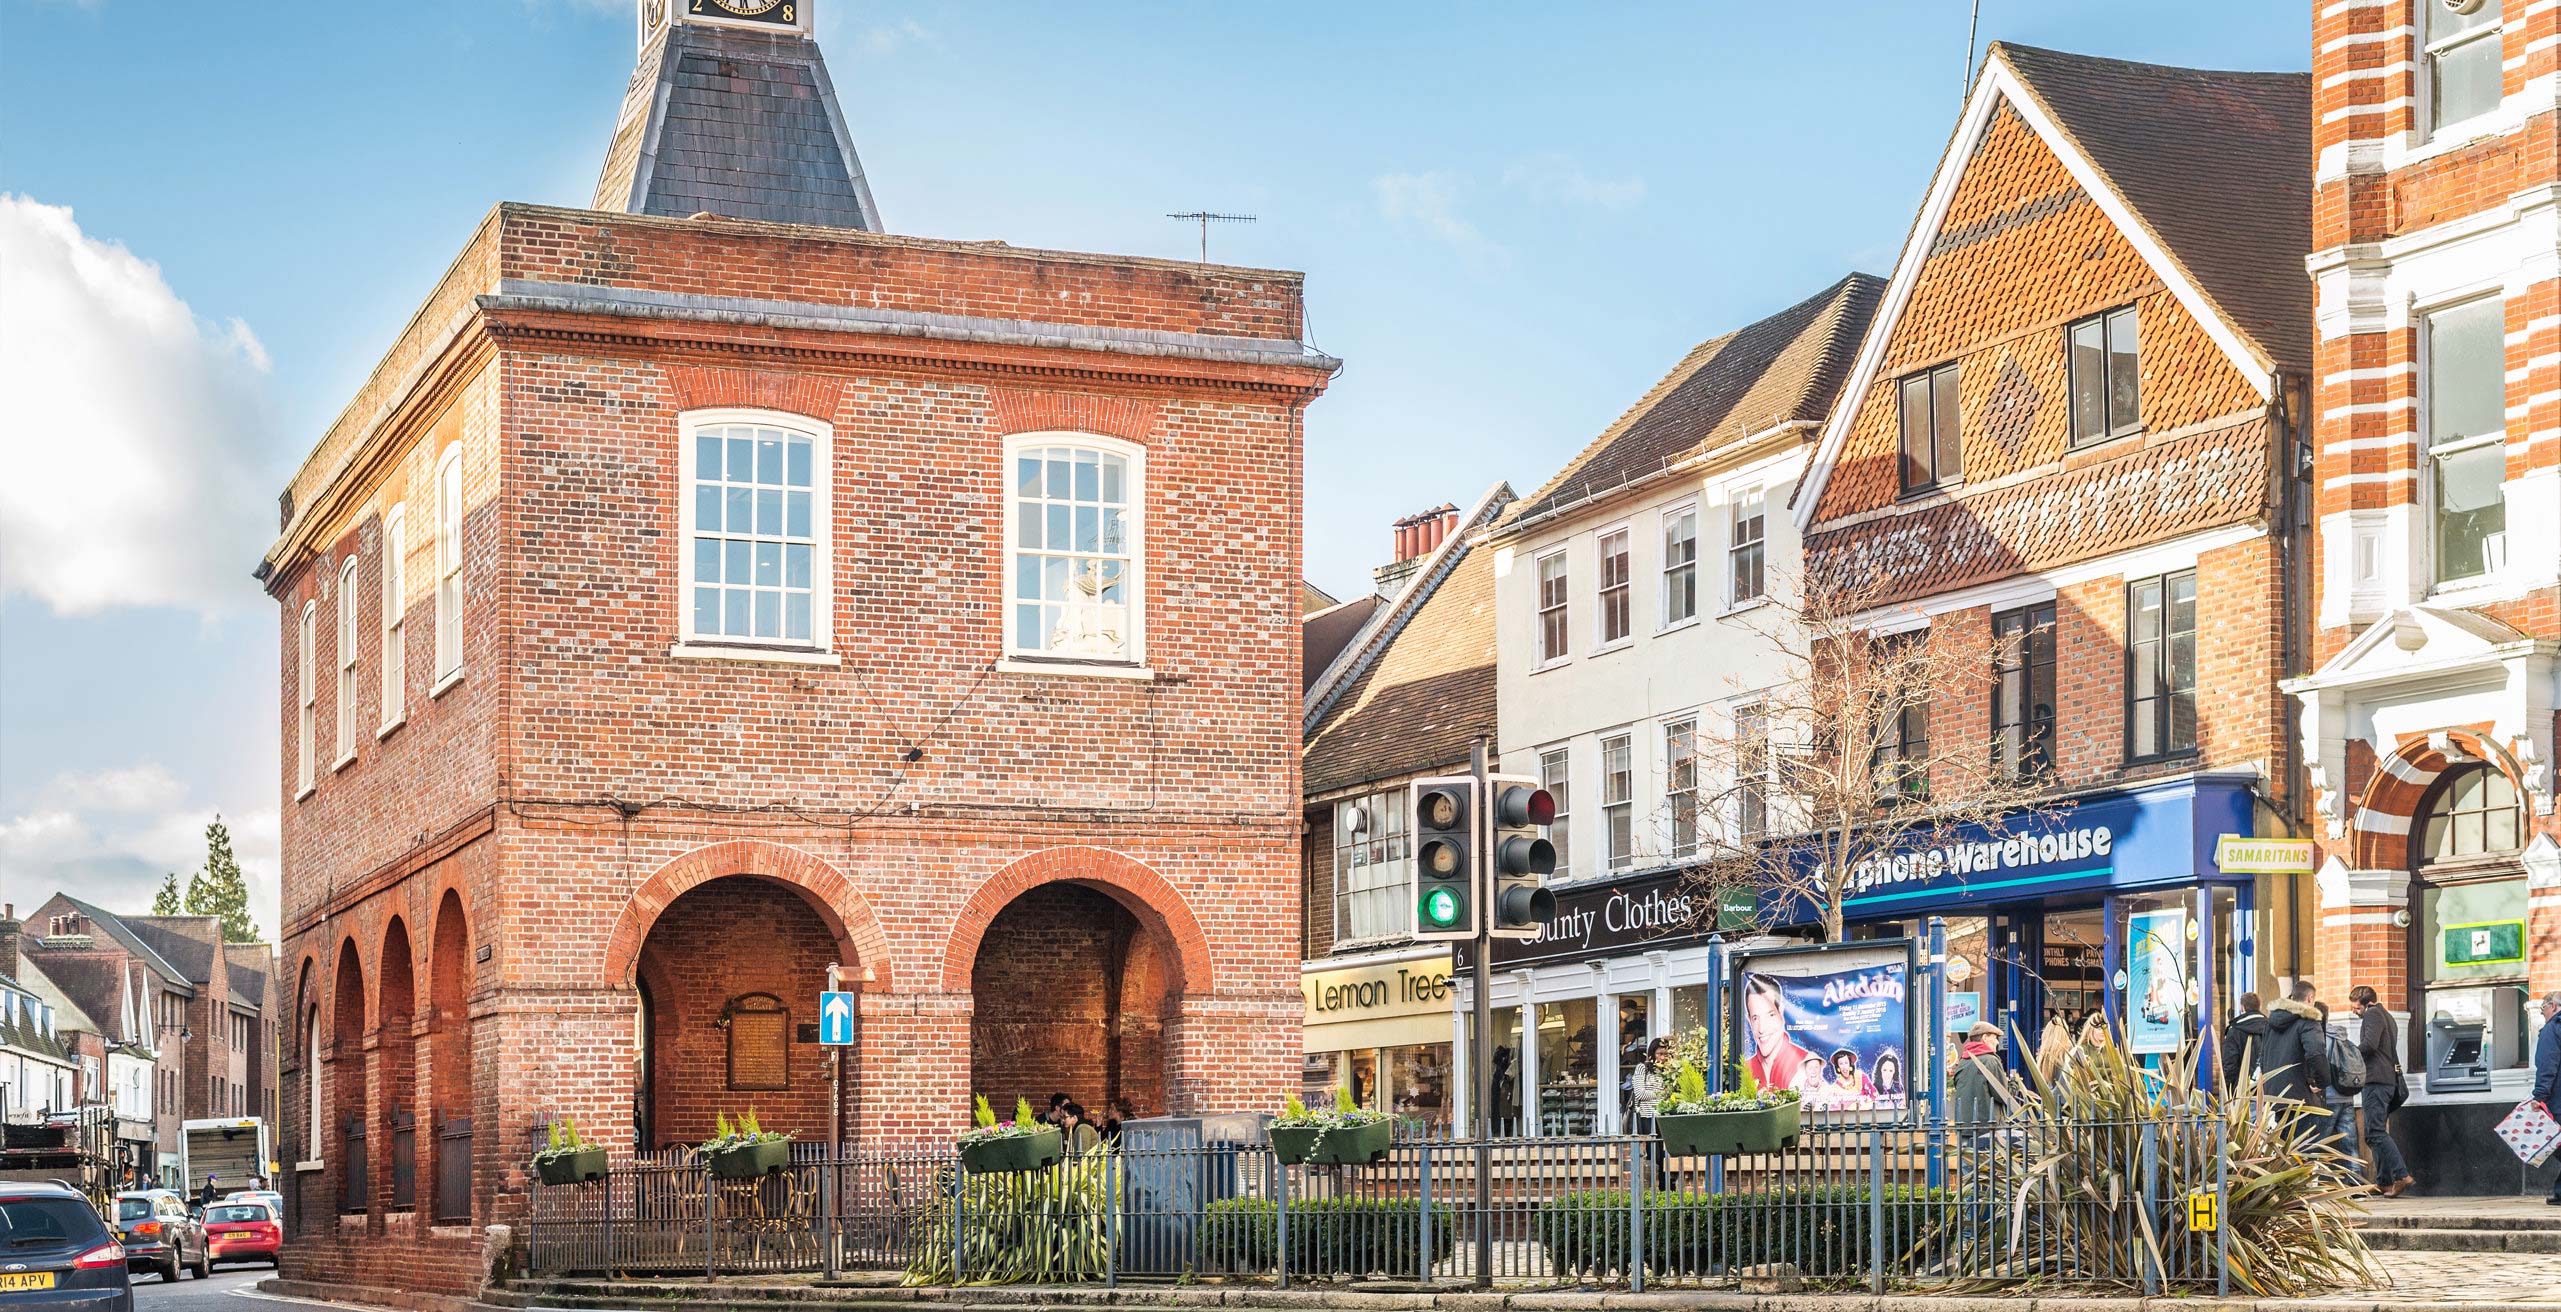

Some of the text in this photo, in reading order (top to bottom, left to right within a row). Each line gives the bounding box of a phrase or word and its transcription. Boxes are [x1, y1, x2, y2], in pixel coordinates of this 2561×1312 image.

[783, 5, 794, 22] 8
[1947, 826, 2112, 874] Warehouse
[2227, 848, 2309, 863] SAMARITANS
[1519, 888, 1693, 949] ounty Clothes
[1723, 902, 1753, 912] Barbour
[1457, 946, 1464, 967] 6
[1315, 969, 1447, 1012] Lemon Tree
[1822, 973, 1903, 1007] Aladdin
[2193, 1197, 2213, 1227] H
[21, 1274, 46, 1287] APV
